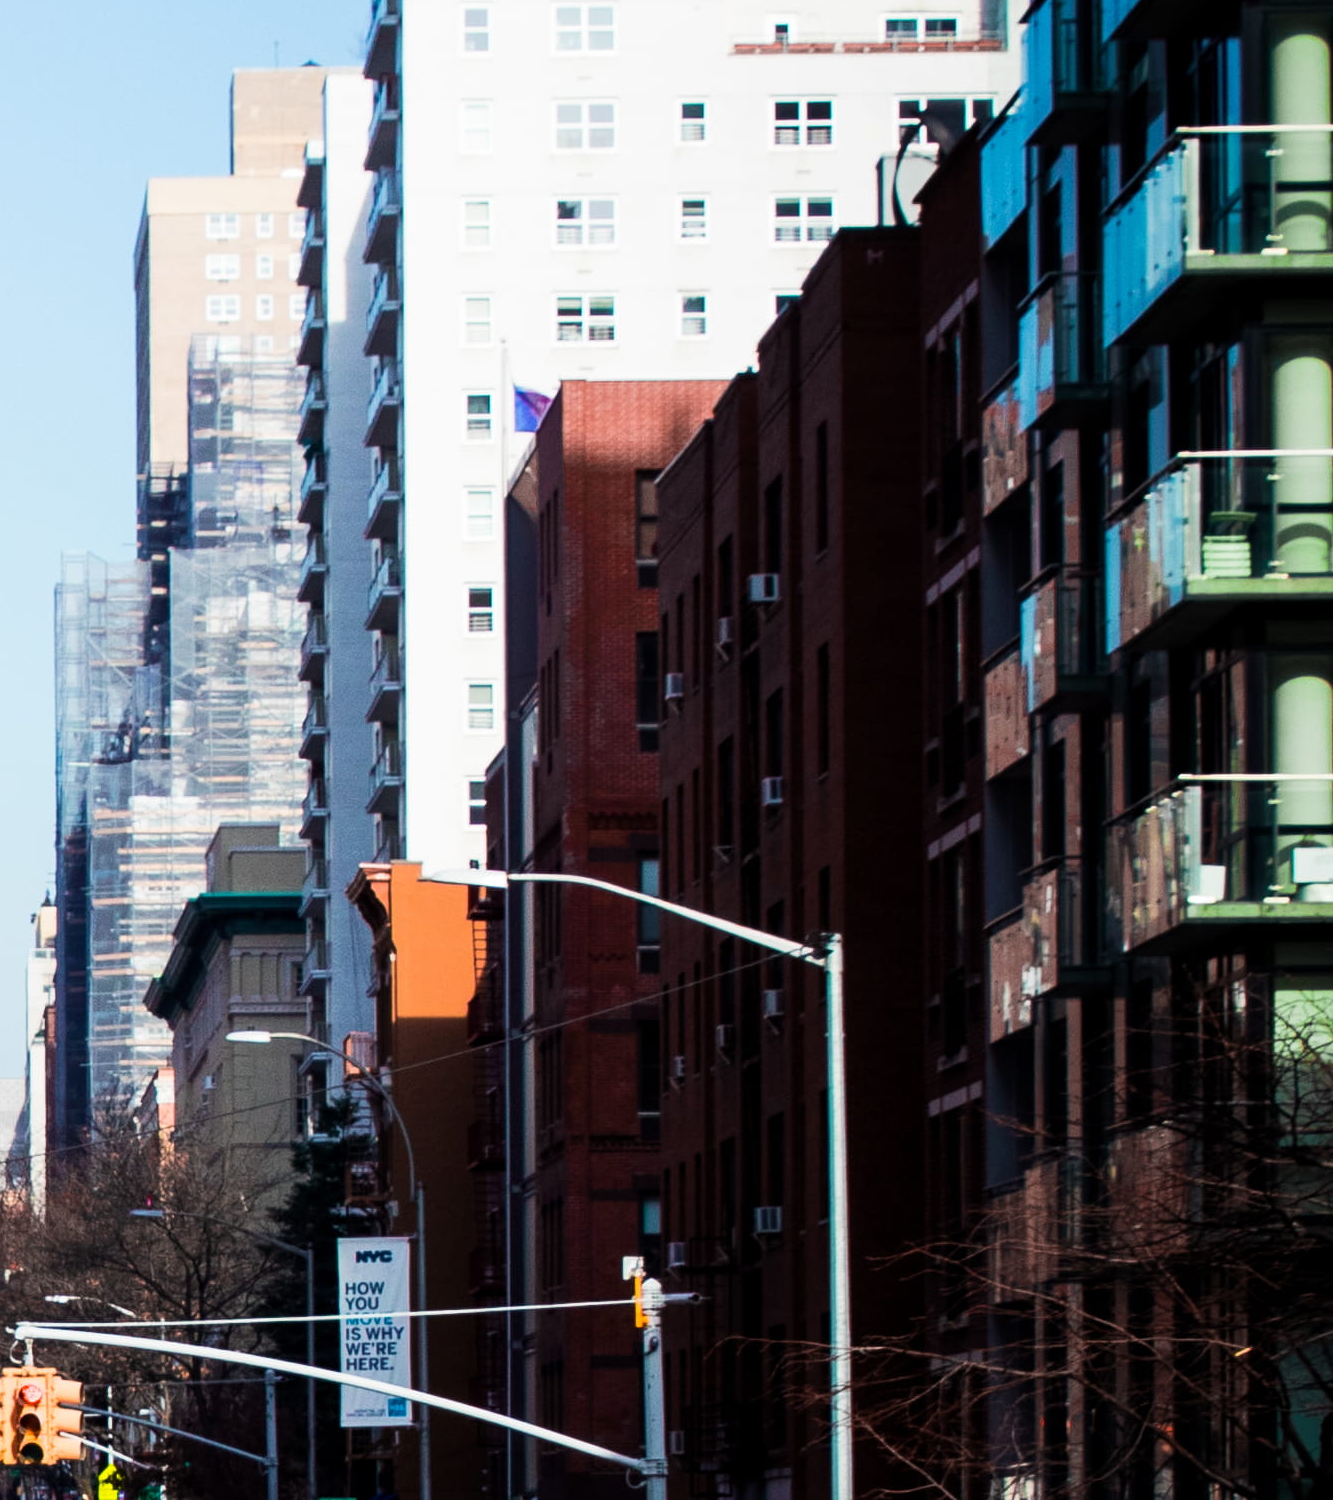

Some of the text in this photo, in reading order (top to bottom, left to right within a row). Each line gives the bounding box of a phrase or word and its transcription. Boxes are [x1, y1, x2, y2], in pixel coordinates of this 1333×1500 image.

[355, 1250, 393, 1264] NYC
[345, 1282, 385, 1296] HOW
[345, 1297, 379, 1310] YOU
[346, 1311, 393, 1326] MOVE
[346, 1326, 405, 1341] IS WHY
[346, 1342, 397, 1356] WE'RE
[346, 1357, 394, 1371] HERE.
